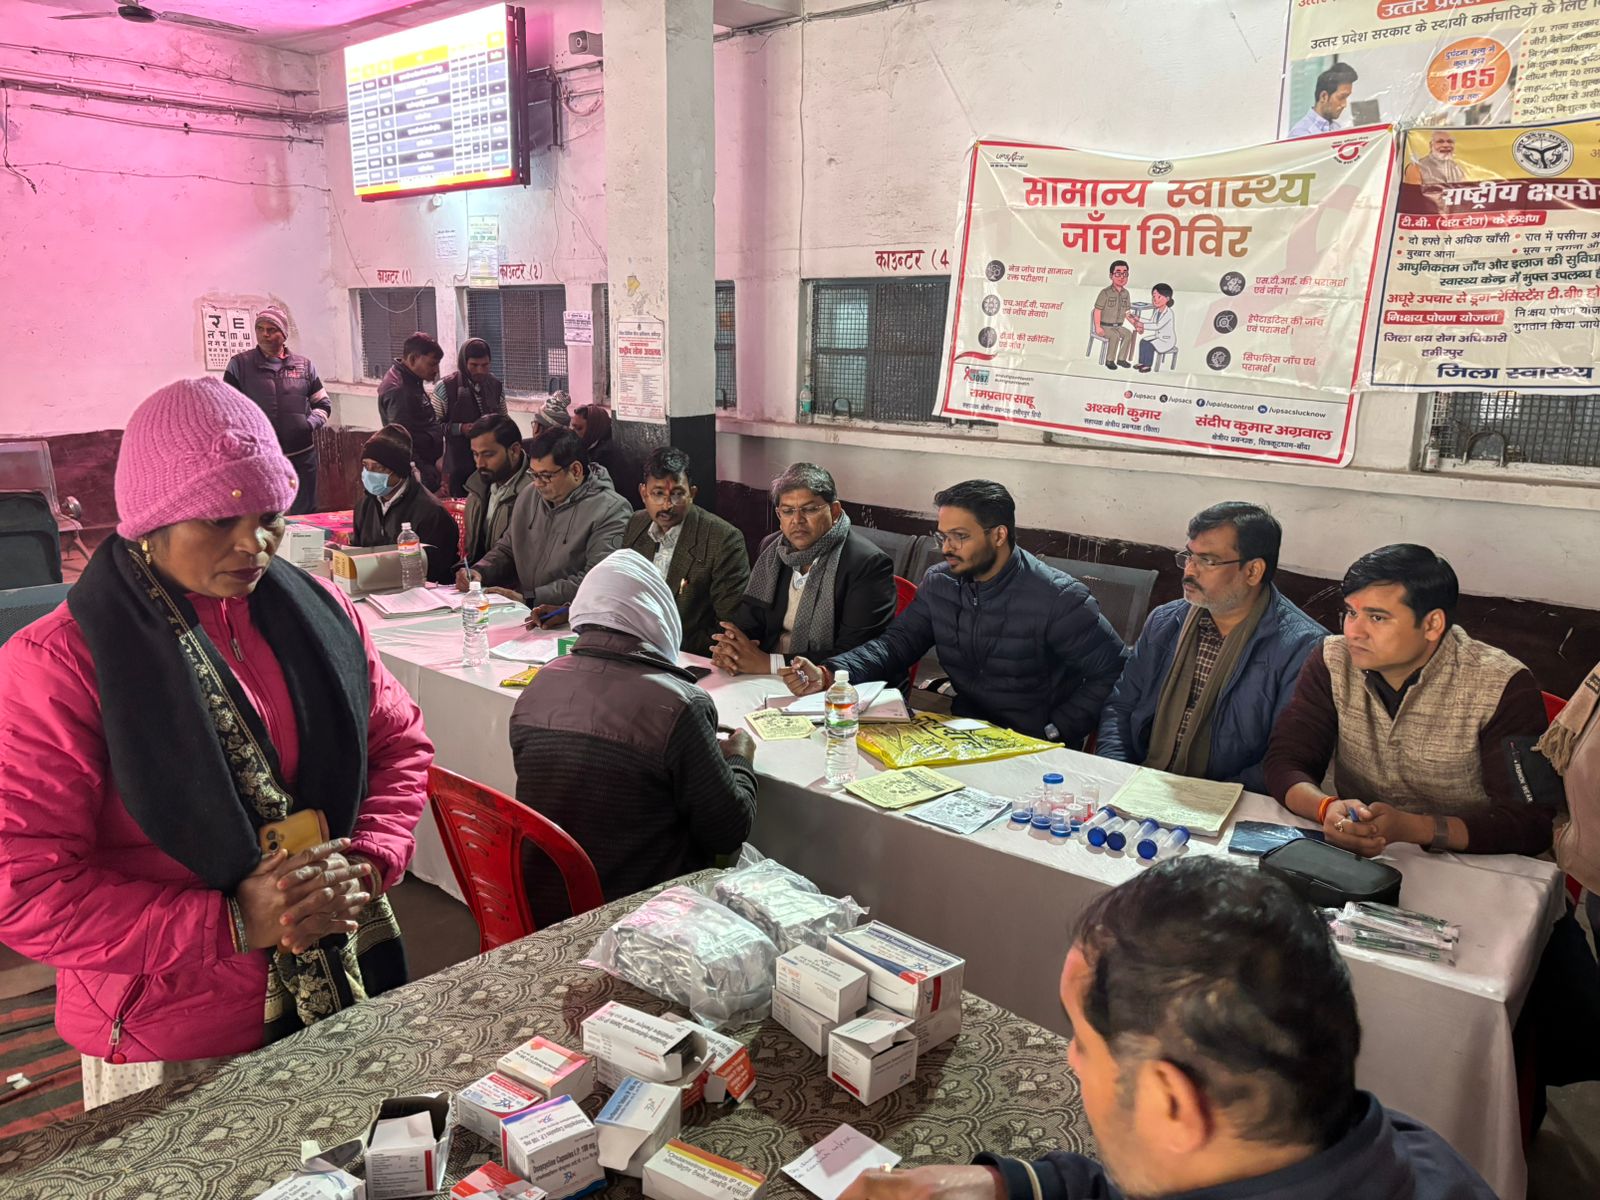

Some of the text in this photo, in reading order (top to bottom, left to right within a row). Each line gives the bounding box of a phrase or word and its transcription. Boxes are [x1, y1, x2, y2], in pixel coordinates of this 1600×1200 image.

[1381, 0, 1428, 17] उत्तर
[1311, 36, 1338, 50] उत्तर
[1341, 29, 1368, 45] प्रदेश
[1372, 25, 1412, 39] सरकार
[1415, 19, 1427, 32] के
[1471, 5, 1537, 25] कर्मचारियों
[1542, 2, 1555, 14] के
[1571, 68, 1581, 76] 20
[1447, 67, 1495, 91] 165
[1023, 173, 1316, 208] सामान्य स्वास्थ्य
[1443, 179, 1600, 209] राष्ट्रीय क्षयरो
[1462, 215, 1489, 228] रोग)
[1507, 214, 1540, 224] लक्षण
[1061, 210, 1252, 257] जाँच शिविर
[1408, 232, 1510, 245] दो हफ्ते से अधिक खाँसी
[1525, 233, 1541, 241] रात
[1545, 230, 1553, 240] में
[1556, 229, 1587, 240] पसीना
[931, 248, 950, 270] (4
[1406, 249, 1455, 259] बुखार आना
[1397, 260, 1460, 275] आधुनिकतम
[1463, 259, 1485, 272] जाँच
[1488, 257, 1508, 269] और
[1511, 257, 1543, 269] इलाज
[1547, 252, 1563, 265] की
[1020, 273, 1043, 283] परीक्षण
[1048, 267, 1073, 276] सामान्य
[1440, 276, 1477, 286] स्वास्थ्य
[1481, 273, 1507, 285] केन्द्र
[1510, 271, 1521, 283] में
[1523, 272, 1548, 286] मुफ्त
[1551, 270, 1592, 280] उपलब्ध
[1299, 276, 1312, 286] की
[1254, 286, 1266, 294] एवं
[1387, 291, 1415, 307] अधूरे
[1417, 294, 1453, 303] उपचार
[1456, 291, 1467, 303] से
[1039, 301, 1064, 311] परामर्श
[1580, 304, 1600, 314] योज
[208, 315, 221, 328] र
[233, 318, 244, 329] E
[1290, 315, 1302, 325] की
[1426, 313, 1456, 322] पोषण
[1459, 313, 1498, 322] योजना
[1247, 324, 1289, 335] एवं परामर्श
[1513, 317, 1600, 334] भुगतान किया जाये
[1384, 332, 1508, 343] जिला क्षय रोग अधिकारी
[1243, 351, 1281, 364] सिफलिस
[1303, 355, 1316, 366] एवं
[1422, 346, 1464, 359] हमीरपुर
[1242, 363, 1271, 373] परामर्श
[1437, 363, 1595, 379] जिला स्वास्थ्य
[1014, 393, 1036, 409] साहू
[1085, 402, 1162, 422] अश्वनी कुमार
[1206, 399, 1254, 411] /upaidscontrol
[1269, 406, 1326, 418] /upsacslucknow
[1195, 413, 1333, 440] संदीप कुमार अग्रवाल
